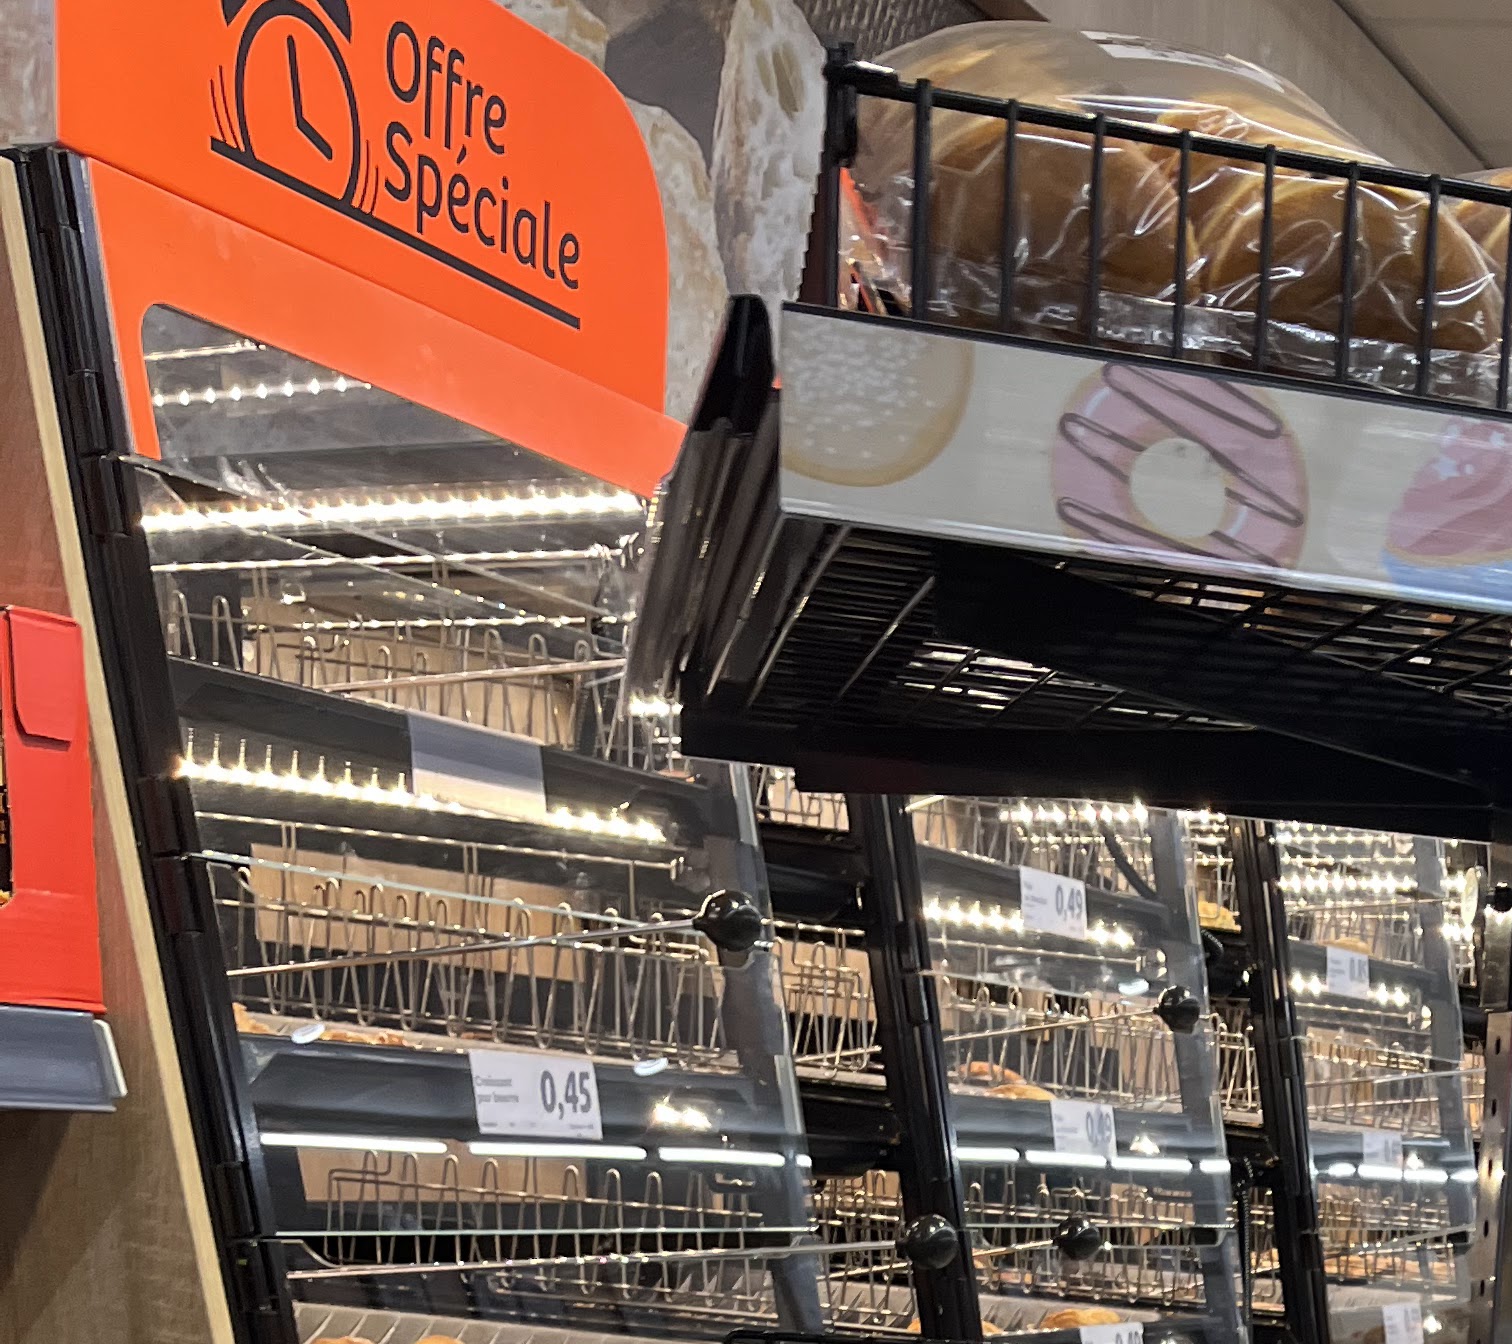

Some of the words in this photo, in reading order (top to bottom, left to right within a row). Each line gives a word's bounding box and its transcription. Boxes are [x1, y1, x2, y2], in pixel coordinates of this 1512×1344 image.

[385, 20, 507, 155] Offre
[384, 121, 581, 290] Spéciale
[540, 1070, 592, 1120] 0,45
